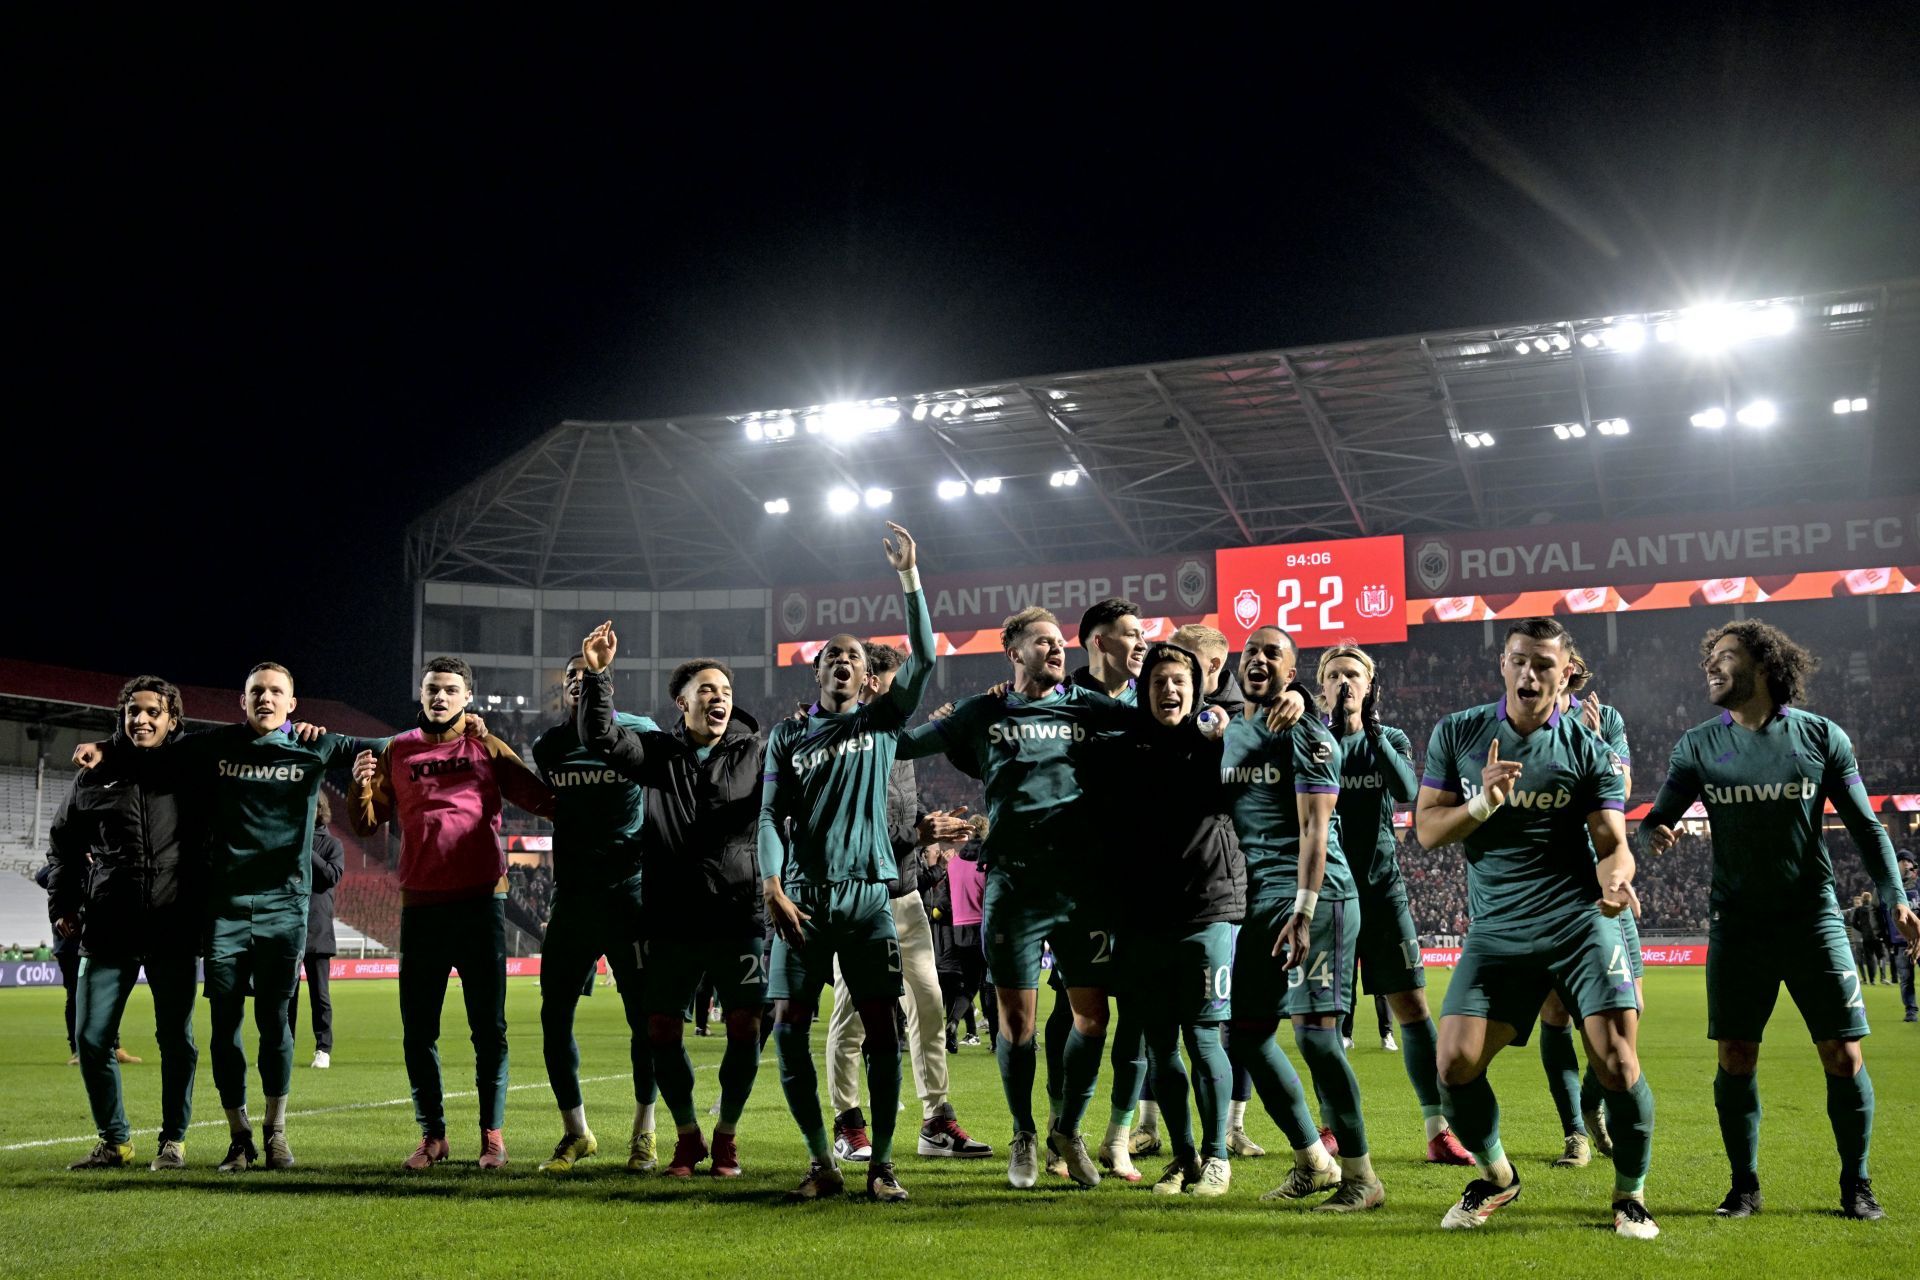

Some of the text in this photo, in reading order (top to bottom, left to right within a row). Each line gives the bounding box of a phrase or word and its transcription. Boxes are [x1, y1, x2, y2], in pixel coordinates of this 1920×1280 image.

[1286, 552, 1332, 567] 94:06
[1459, 516, 1904, 580] ROYAL ANTWERP FC
[815, 572, 1168, 626] ROYA ANTWERP FC
[1277, 575, 1345, 633] 2-2
[987, 722, 1086, 744] Sunweb
[217, 758, 305, 783] Sunweb
[792, 731, 874, 776] Sunweb
[1220, 761, 1281, 785] unweb
[1460, 776, 1572, 810] Suweb
[1703, 777, 1816, 806] Sunweb
[886, 938, 901, 973] 5
[1399, 939, 1424, 970] 12
[1422, 953, 1452, 963] MEDIA
[1606, 944, 1633, 983] 4
[16, 962, 56, 985] Croky
[1203, 964, 1232, 999] 10
[1842, 970, 1865, 1008] 2
